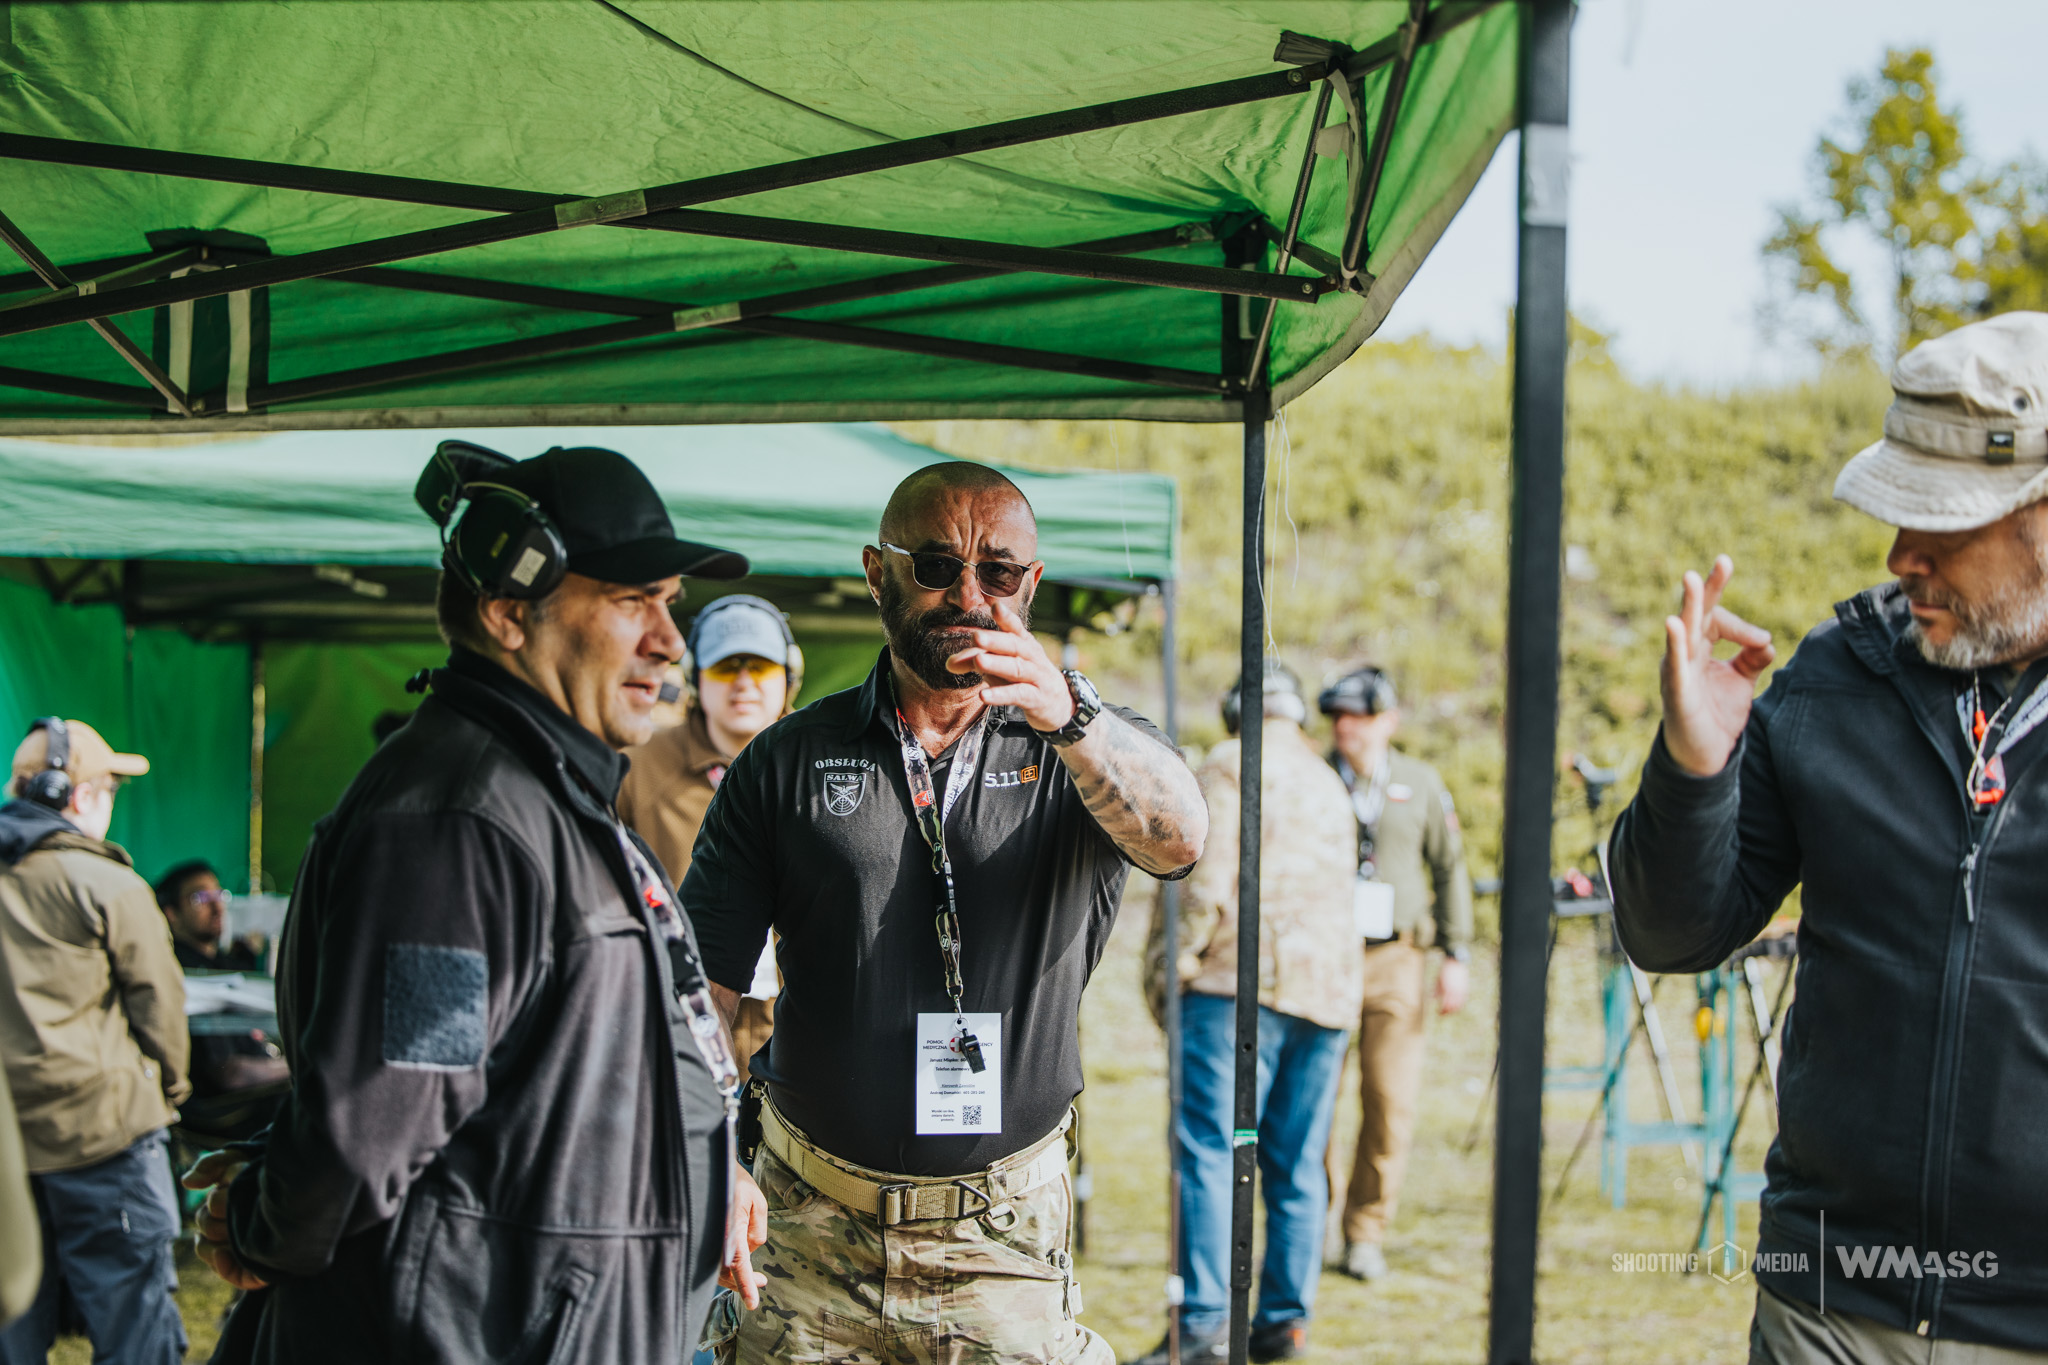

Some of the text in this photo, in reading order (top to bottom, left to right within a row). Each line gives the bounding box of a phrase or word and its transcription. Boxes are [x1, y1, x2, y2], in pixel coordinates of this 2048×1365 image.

[814, 757, 876, 772] OBSŁUGA
[826, 774, 863, 782] SALWA
[984, 770, 1021, 788] 5.11
